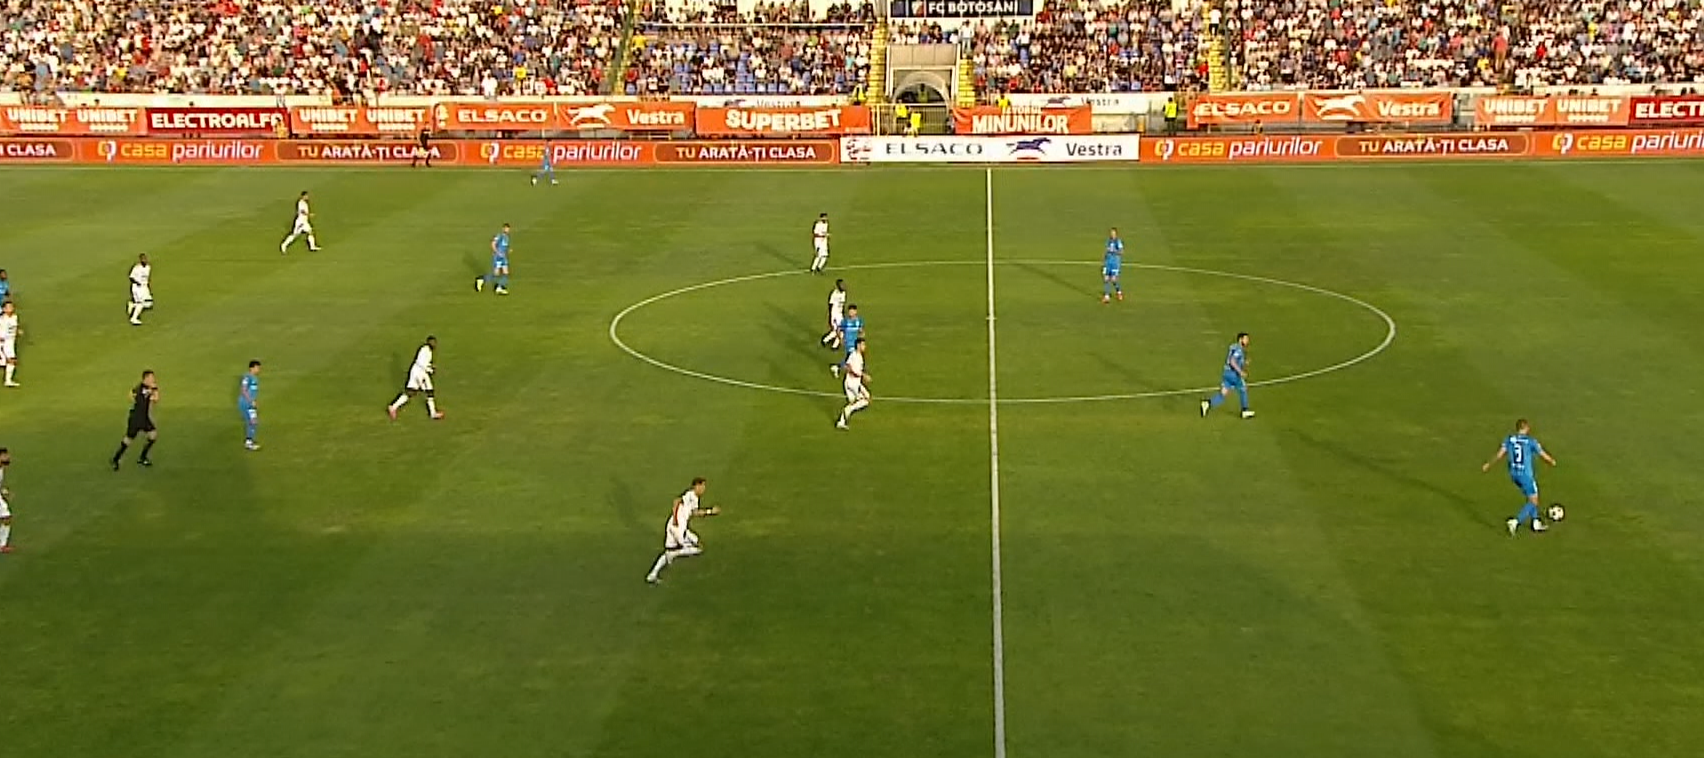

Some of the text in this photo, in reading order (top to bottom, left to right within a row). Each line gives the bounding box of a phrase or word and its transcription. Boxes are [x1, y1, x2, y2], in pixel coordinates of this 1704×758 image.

[1200, 100, 1291, 117] ELSACO
[1377, 102, 1442, 118] Vestra
[1484, 98, 1622, 115] UNIBET UNIBET
[7, 107, 138, 123] UNIBET UNIBET
[299, 108, 426, 123] UNIBET UNIBET
[458, 108, 548, 123] ELSACO
[627, 108, 685, 125] Vestra
[725, 108, 843, 132] SUPERBET
[972, 114, 1070, 135] MINUNILOR
[6, 143, 57, 157] CLASA
[886, 142, 1122, 156] ELSACO Vestra
[1178, 136, 1323, 160] casa pariurilor
[1358, 140, 1380, 153] TU
[1458, 138, 1509, 152] CLASA
[1576, 135, 1627, 151] casa
[121, 140, 265, 164] casa pariurilor
[297, 145, 319, 158] TU
[553, 141, 642, 164] pariurilor
[676, 146, 696, 159] TU
[768, 146, 817, 159] CLASA
